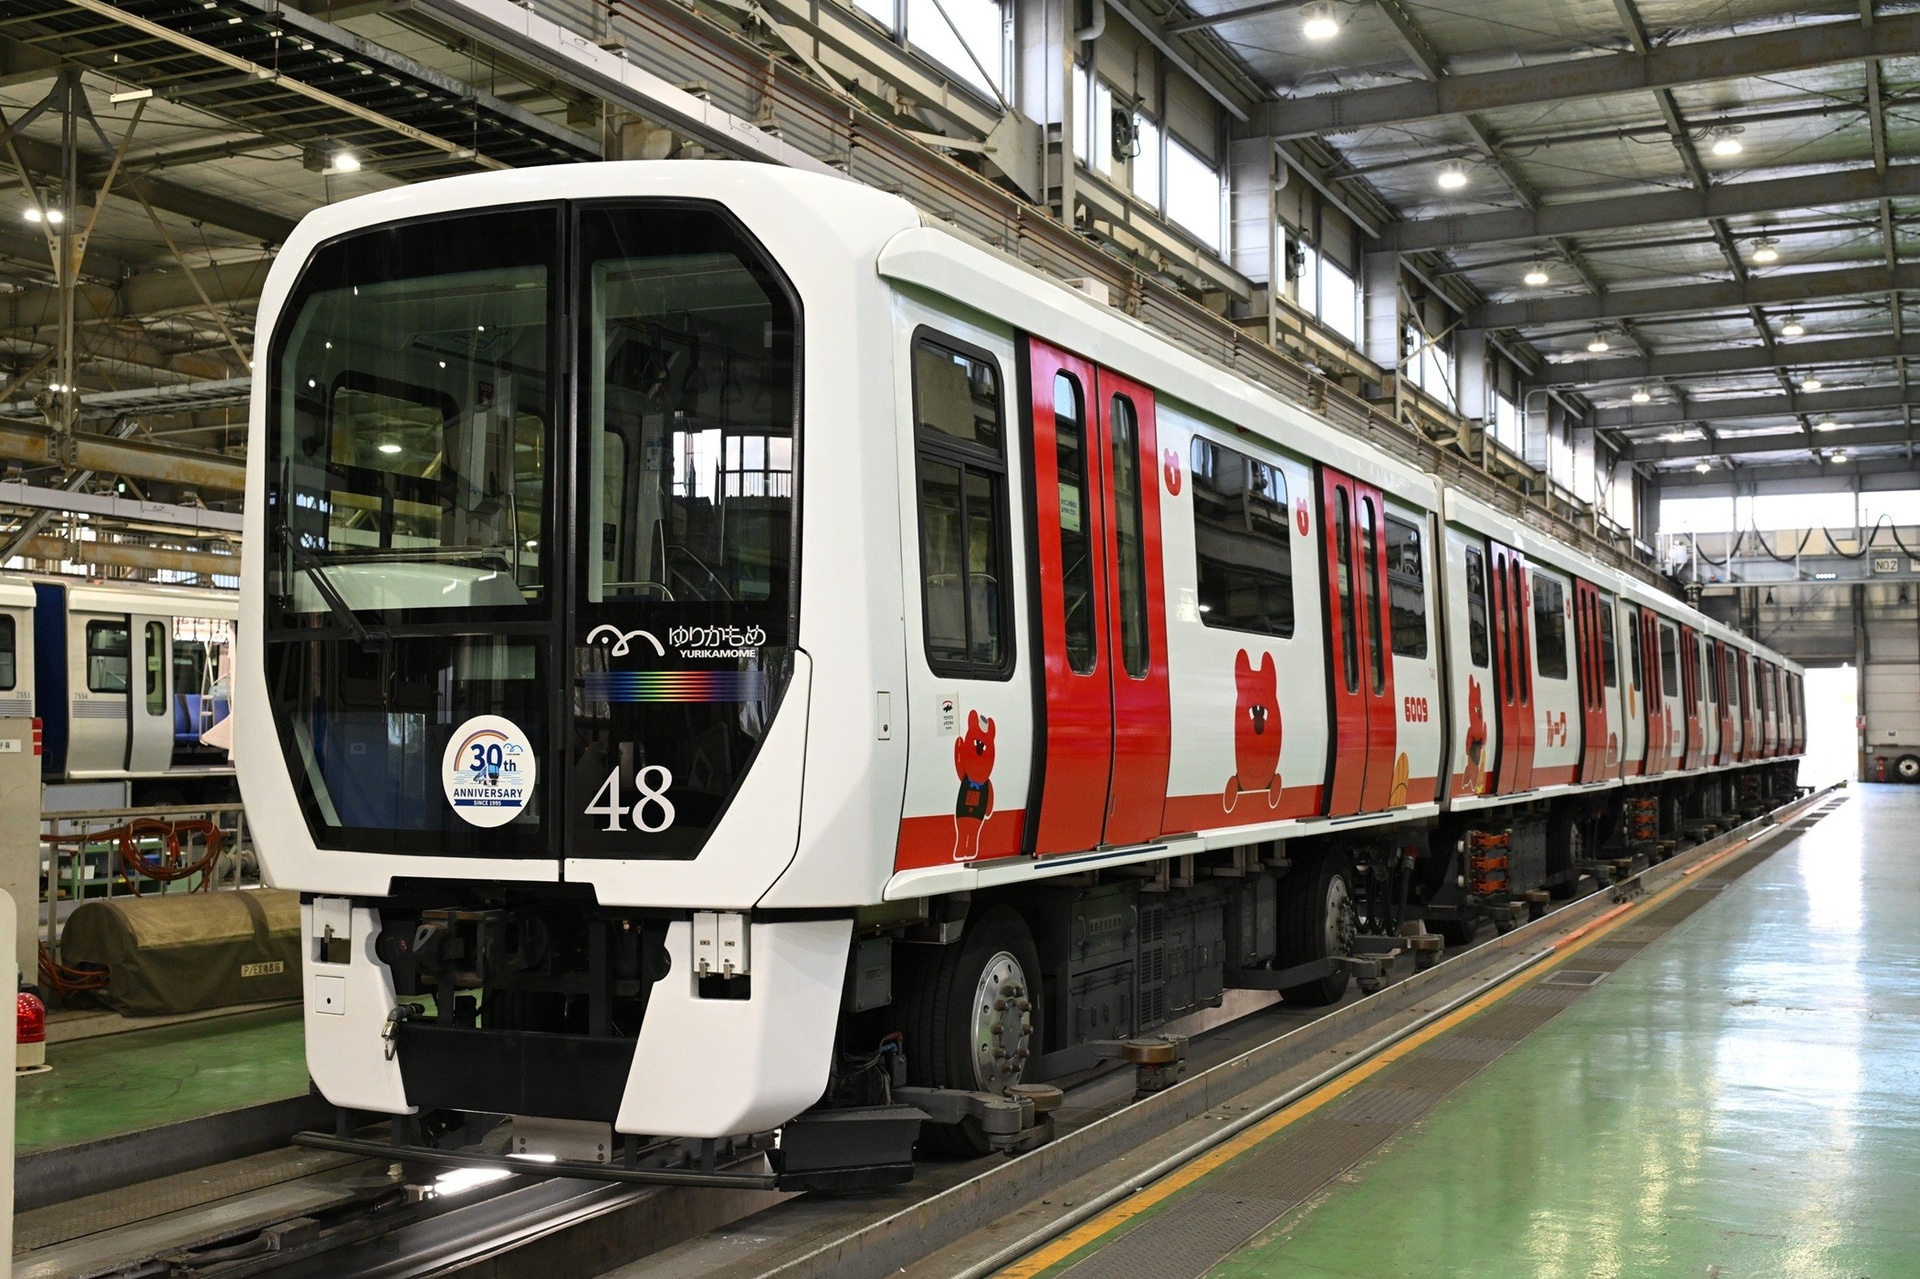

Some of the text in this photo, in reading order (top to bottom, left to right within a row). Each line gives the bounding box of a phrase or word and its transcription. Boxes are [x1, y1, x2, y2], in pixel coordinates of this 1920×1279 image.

[668, 624, 767, 648] ゆりかもめ
[679, 649, 756, 659] YURIKAMOME
[1404, 696, 1429, 722] 6009
[453, 788, 523, 798] ANNIVERSARY
[584, 765, 675, 833] 48
